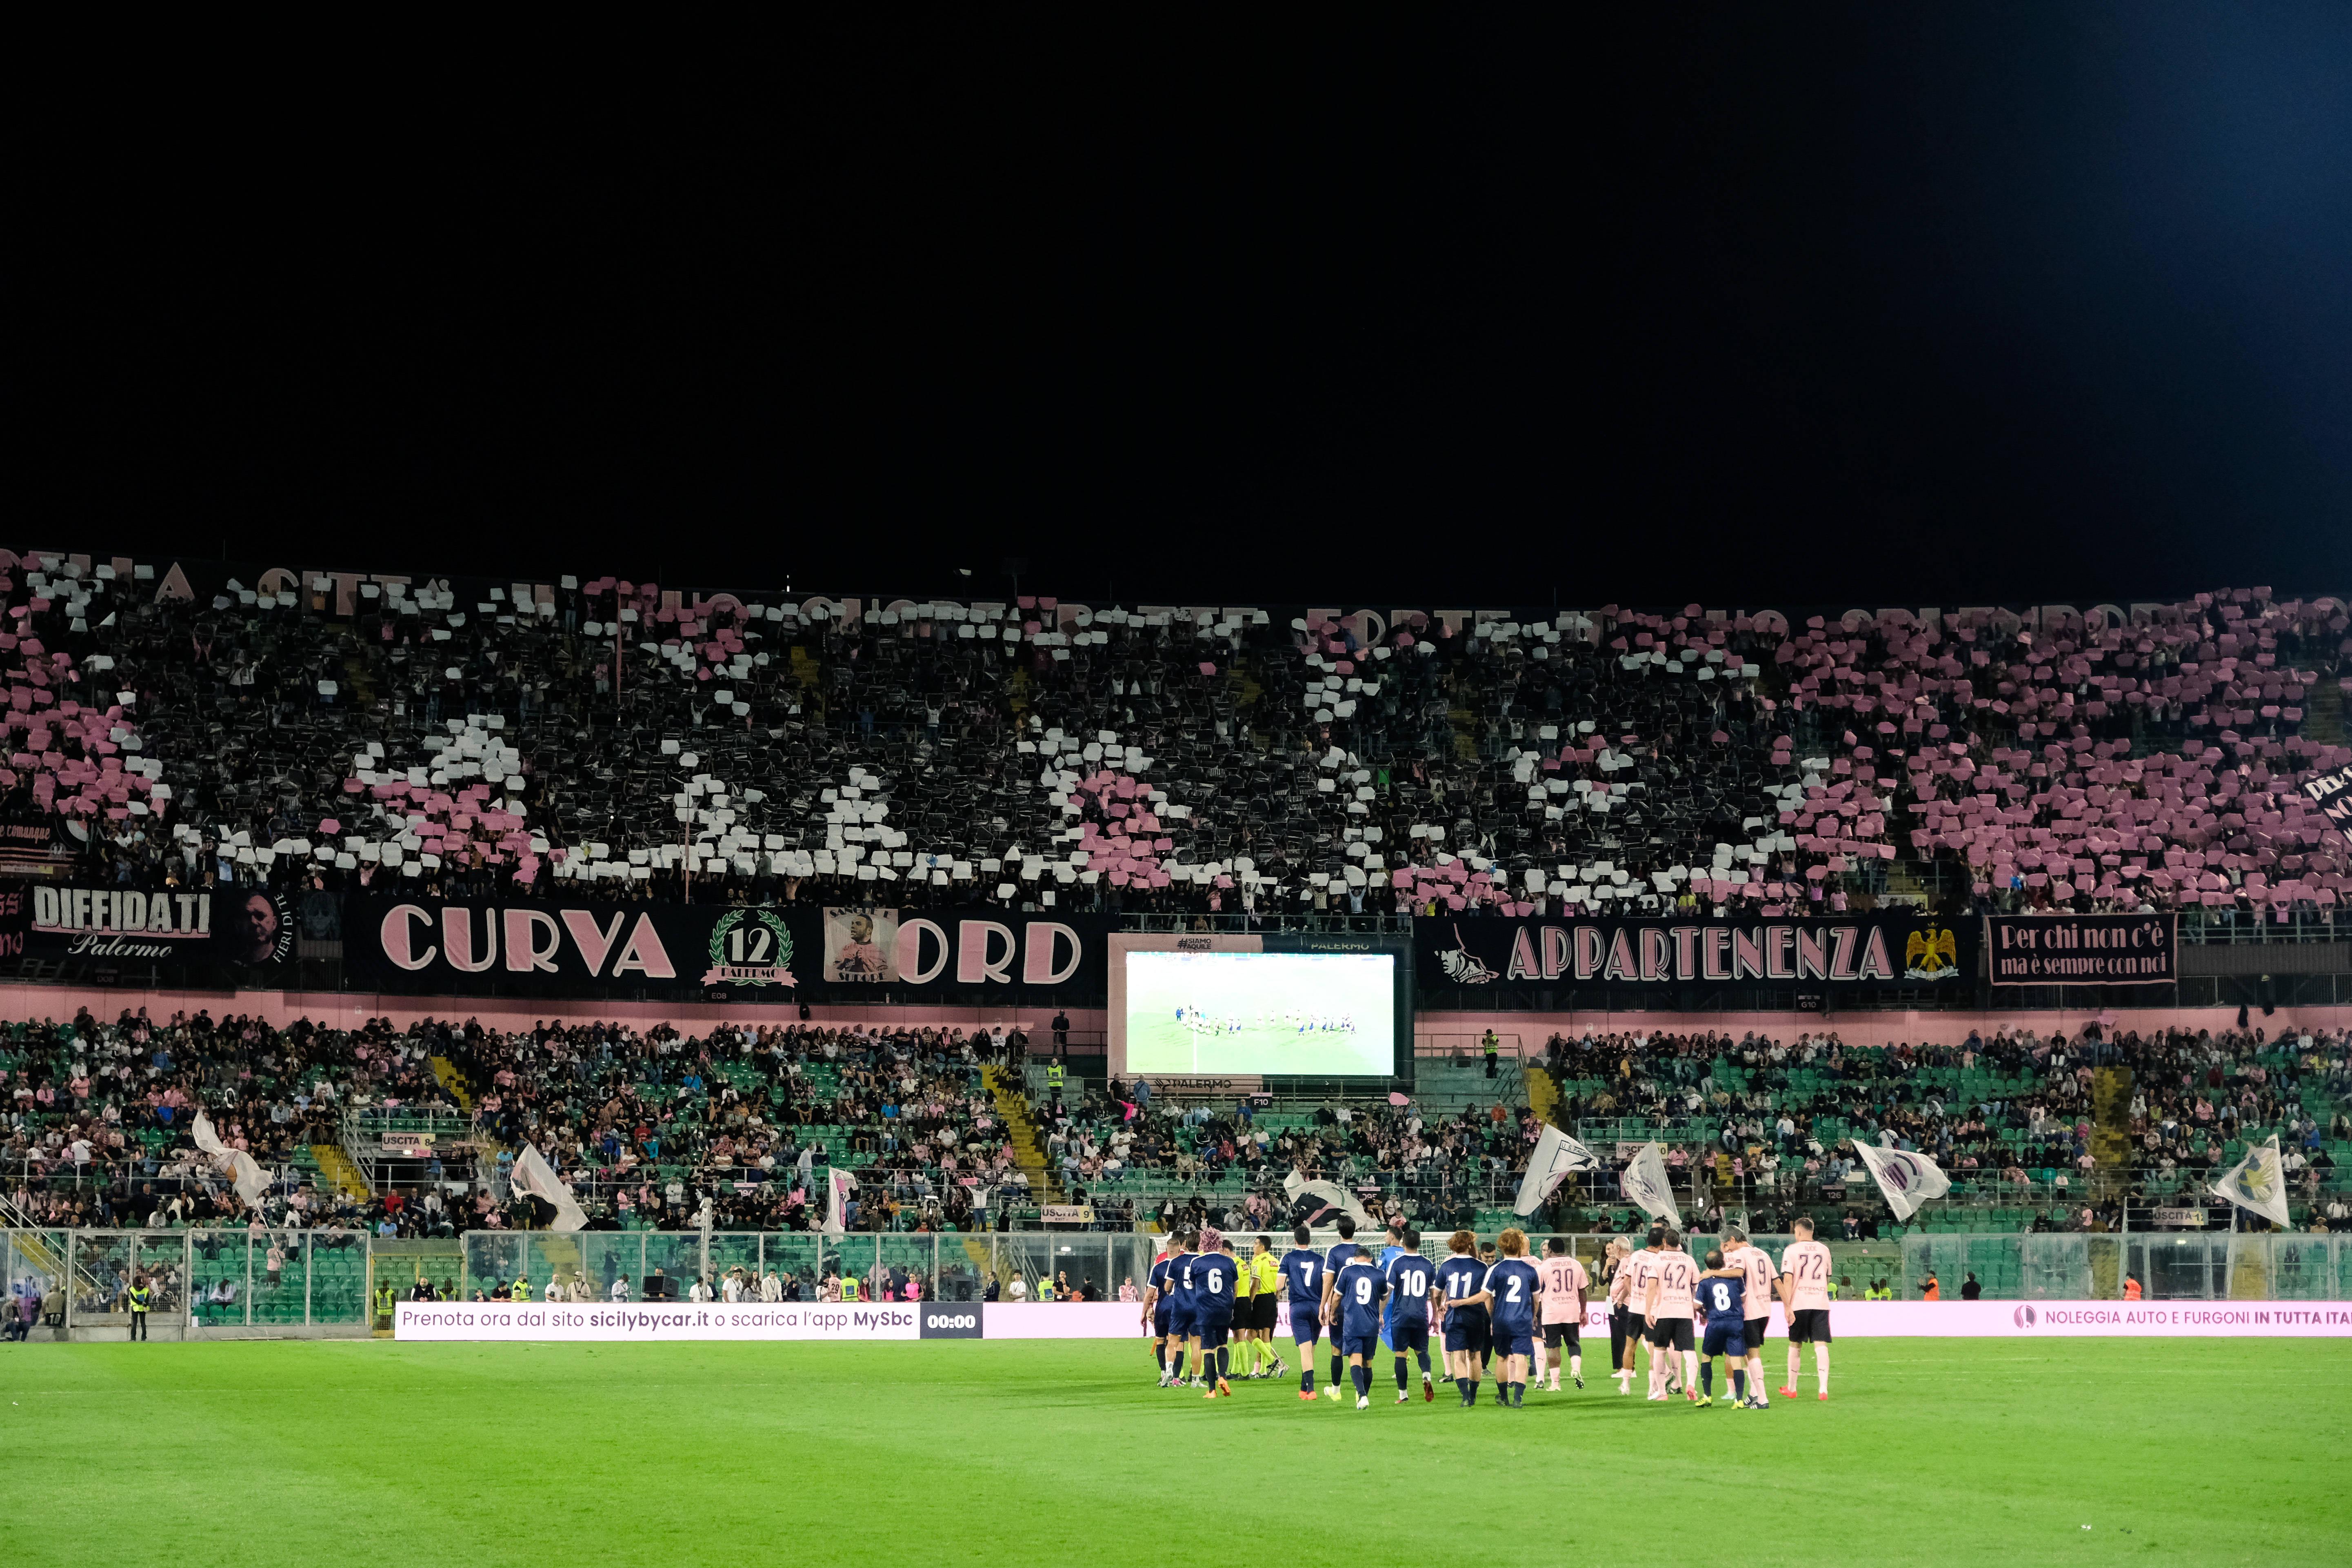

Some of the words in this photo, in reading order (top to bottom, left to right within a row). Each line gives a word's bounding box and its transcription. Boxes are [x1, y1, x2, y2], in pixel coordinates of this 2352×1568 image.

[7, 824, 51, 844] comunque
[34, 886, 210, 934] DIFFIDATI
[274, 892, 287, 910] TE
[281, 911, 293, 926] DI
[67, 931, 173, 958] Palermo
[272, 931, 292, 964] FIERI
[380, 904, 677, 979] CURVA
[897, 918, 1082, 984] ORD
[728, 927, 771, 962] 12
[2001, 925, 2039, 949] Per
[2044, 923, 2078, 949] chi
[2084, 928, 2127, 948] non
[1507, 926, 1894, 980] APPARTENENZA
[2001, 957, 2027, 975] ma
[2031, 953, 2040, 974] è
[2044, 957, 2105, 975] sempre
[2108, 957, 2137, 975] con
[2141, 951, 2167, 973] noi
[721, 968, 780, 978] PALERMO
[1173, 1079, 1232, 1089] PALERMO
[383, 1136, 420, 1145] USCITA
[2154, 1212, 2192, 1221] USCITA
[1300, 1262, 1314, 1287] 7
[1664, 1262, 1686, 1290] 42
[1758, 1258, 1766, 1286] 9
[1798, 1253, 1823, 1280] 72
[1208, 1268, 1223, 1294] 6
[1356, 1277, 1372, 1305] 9
[1400, 1269, 1426, 1297] 10
[1448, 1272, 1472, 1298] 11
[1506, 1275, 1521, 1303] 2
[1552, 1268, 1573, 1293] 30
[1712, 1283, 1731, 1311] 8
[403, 1311, 474, 1326] Prenota
[481, 1314, 511, 1326] ora
[517, 1311, 545, 1326] dal
[552, 1311, 584, 1326] sito
[590, 1311, 708, 1331] sicilybycar.it
[715, 1315, 725, 1326] o
[732, 1311, 797, 1326] scarica
[854, 1311, 913, 1330] MySbc
[927, 1315, 976, 1329] 00:00
[2046, 1311, 2121, 1324] NOLEGGIA
[2126, 1311, 2167, 1324] AUTO
[2172, 1311, 2179, 1324] E
[2185, 1311, 2249, 1324] FURGONI
[2255, 1311, 2270, 1324] IN
[2274, 1311, 2322, 1324] TUTTA
[2327, 1311, 2352, 1324] ITA
